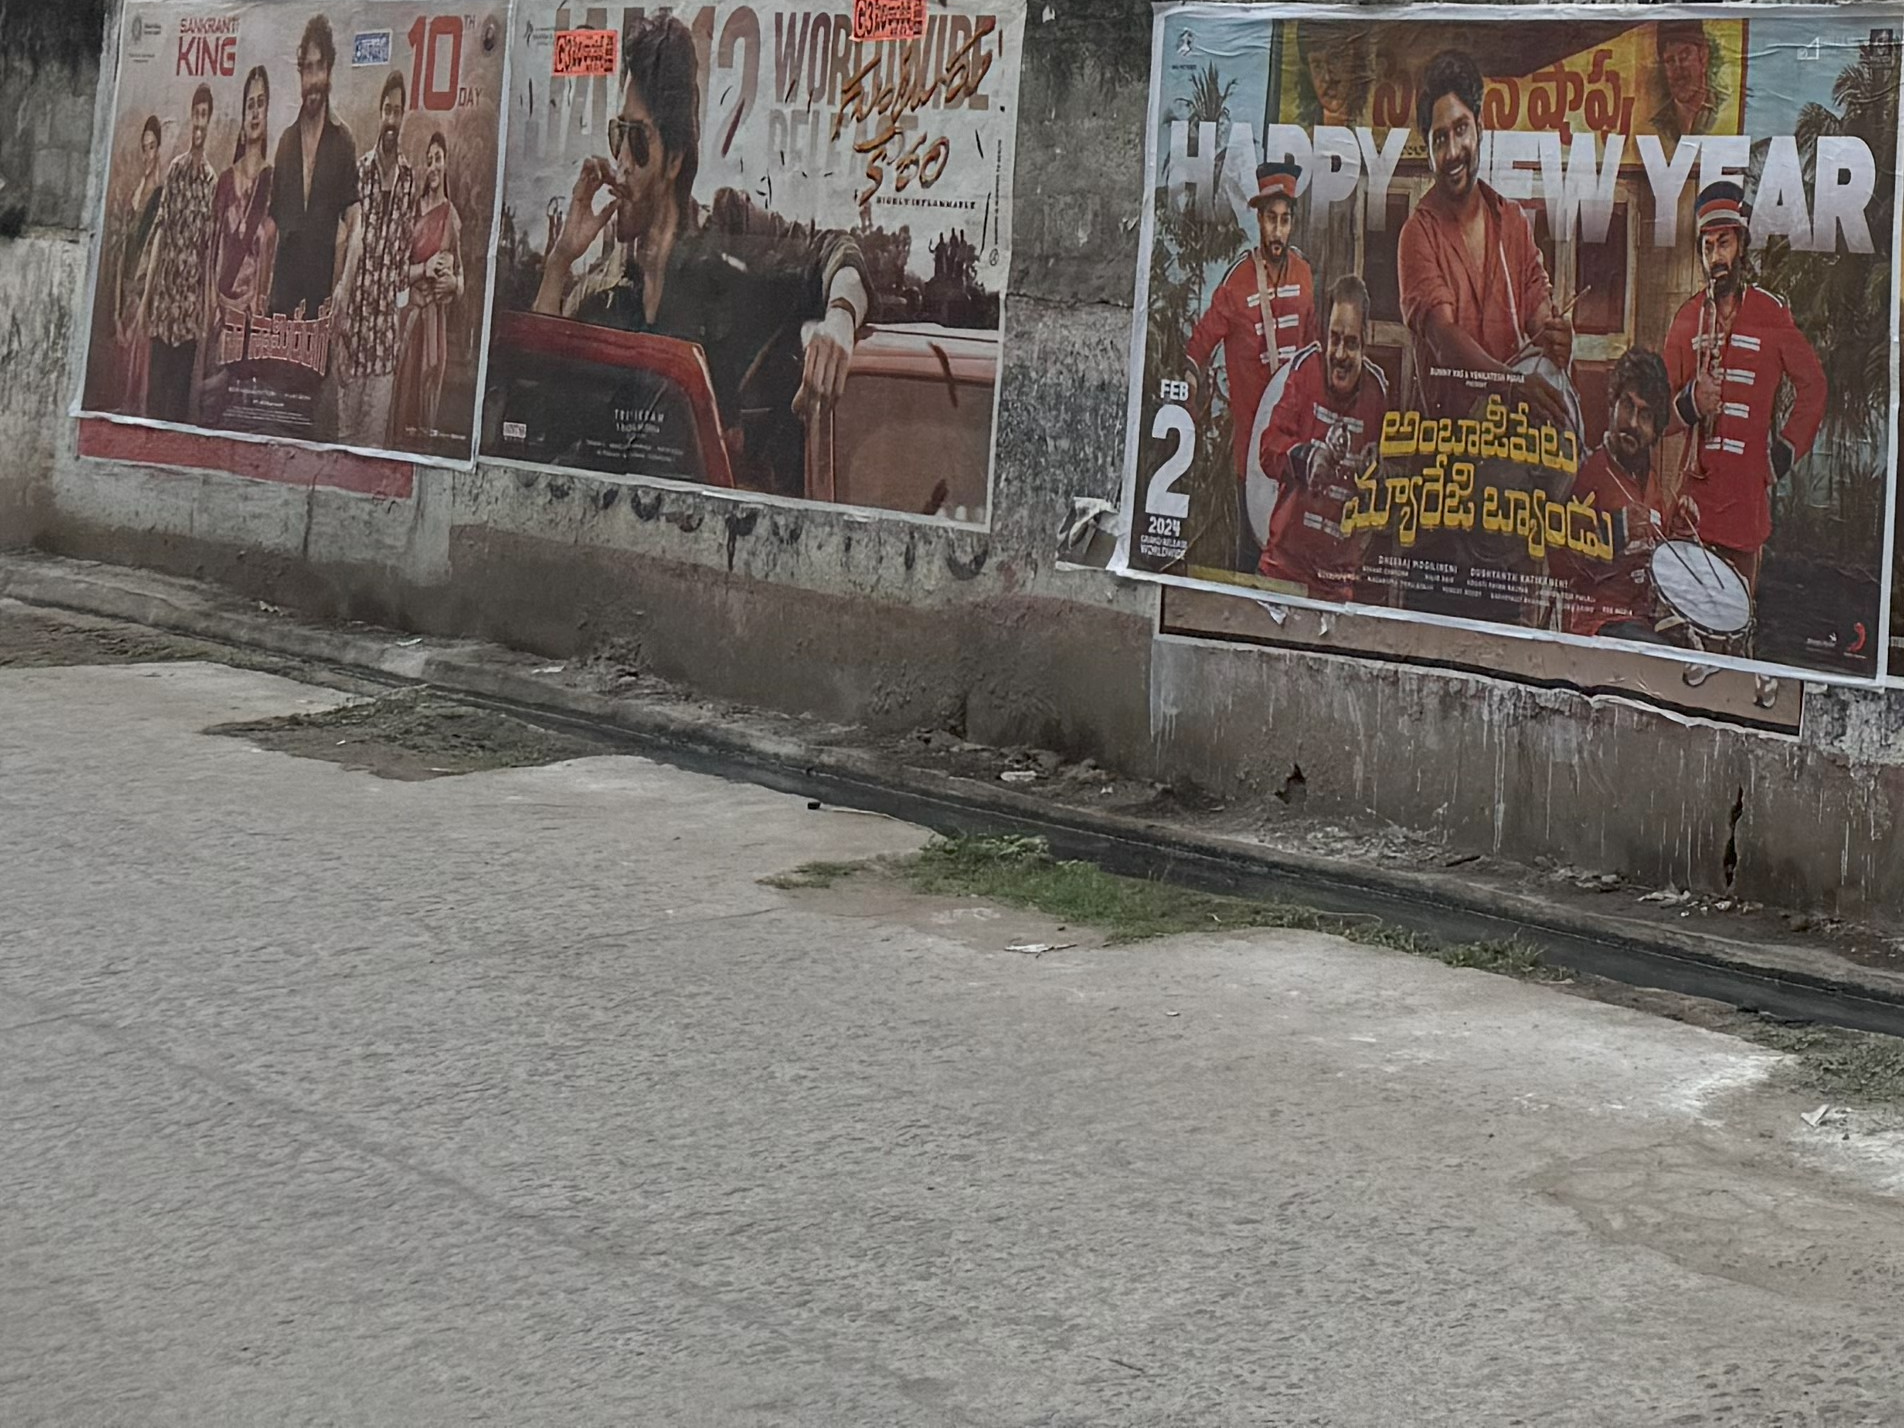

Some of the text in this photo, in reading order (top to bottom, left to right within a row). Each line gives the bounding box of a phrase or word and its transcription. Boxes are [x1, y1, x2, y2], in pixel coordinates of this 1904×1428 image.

[177, 36, 237, 76] KING
[407, 15, 476, 111] 10 TH
[459, 87, 482, 107] DAY
[1164, 120, 1411, 236] HAPPY
[1160, 379, 1189, 401] FEB
[1145, 404, 1196, 519] 2
[1148, 515, 1181, 537] 2024
